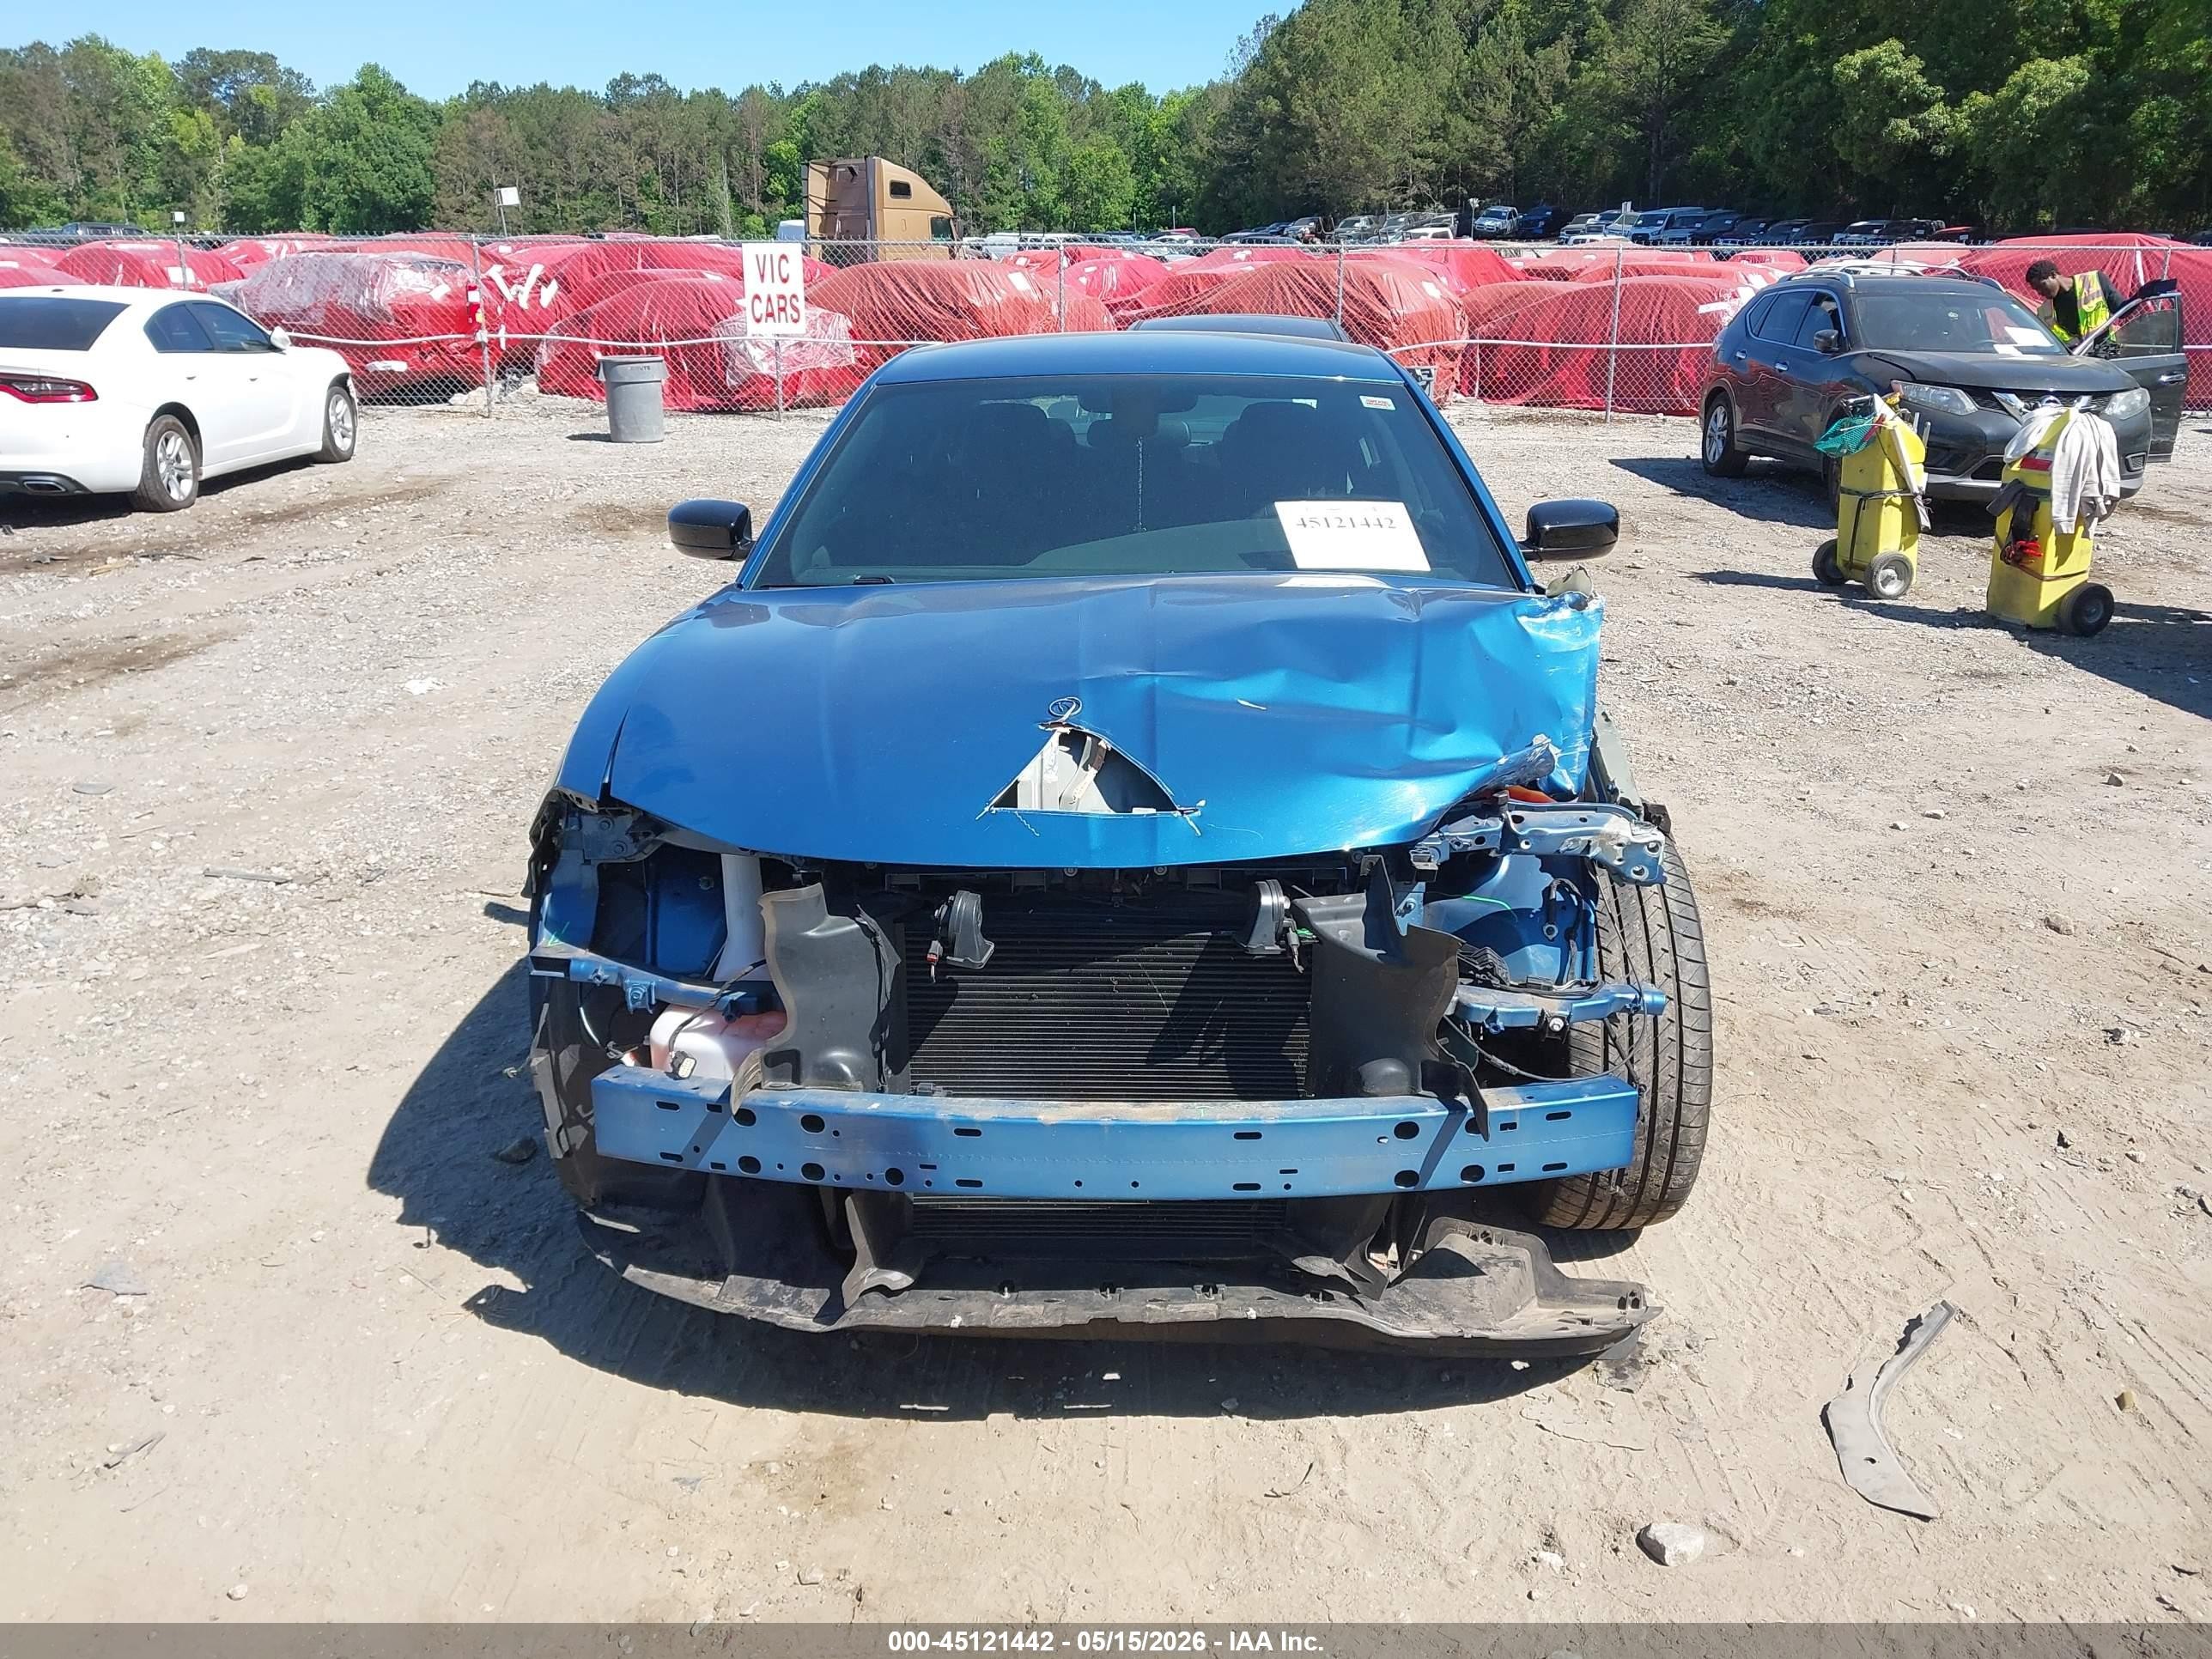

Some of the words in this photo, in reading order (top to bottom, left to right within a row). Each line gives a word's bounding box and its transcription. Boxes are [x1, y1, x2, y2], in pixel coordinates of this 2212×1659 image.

[756, 253, 790, 284] VIC
[751, 293, 800, 324] CARS
[1296, 516, 1397, 529] 45121442
